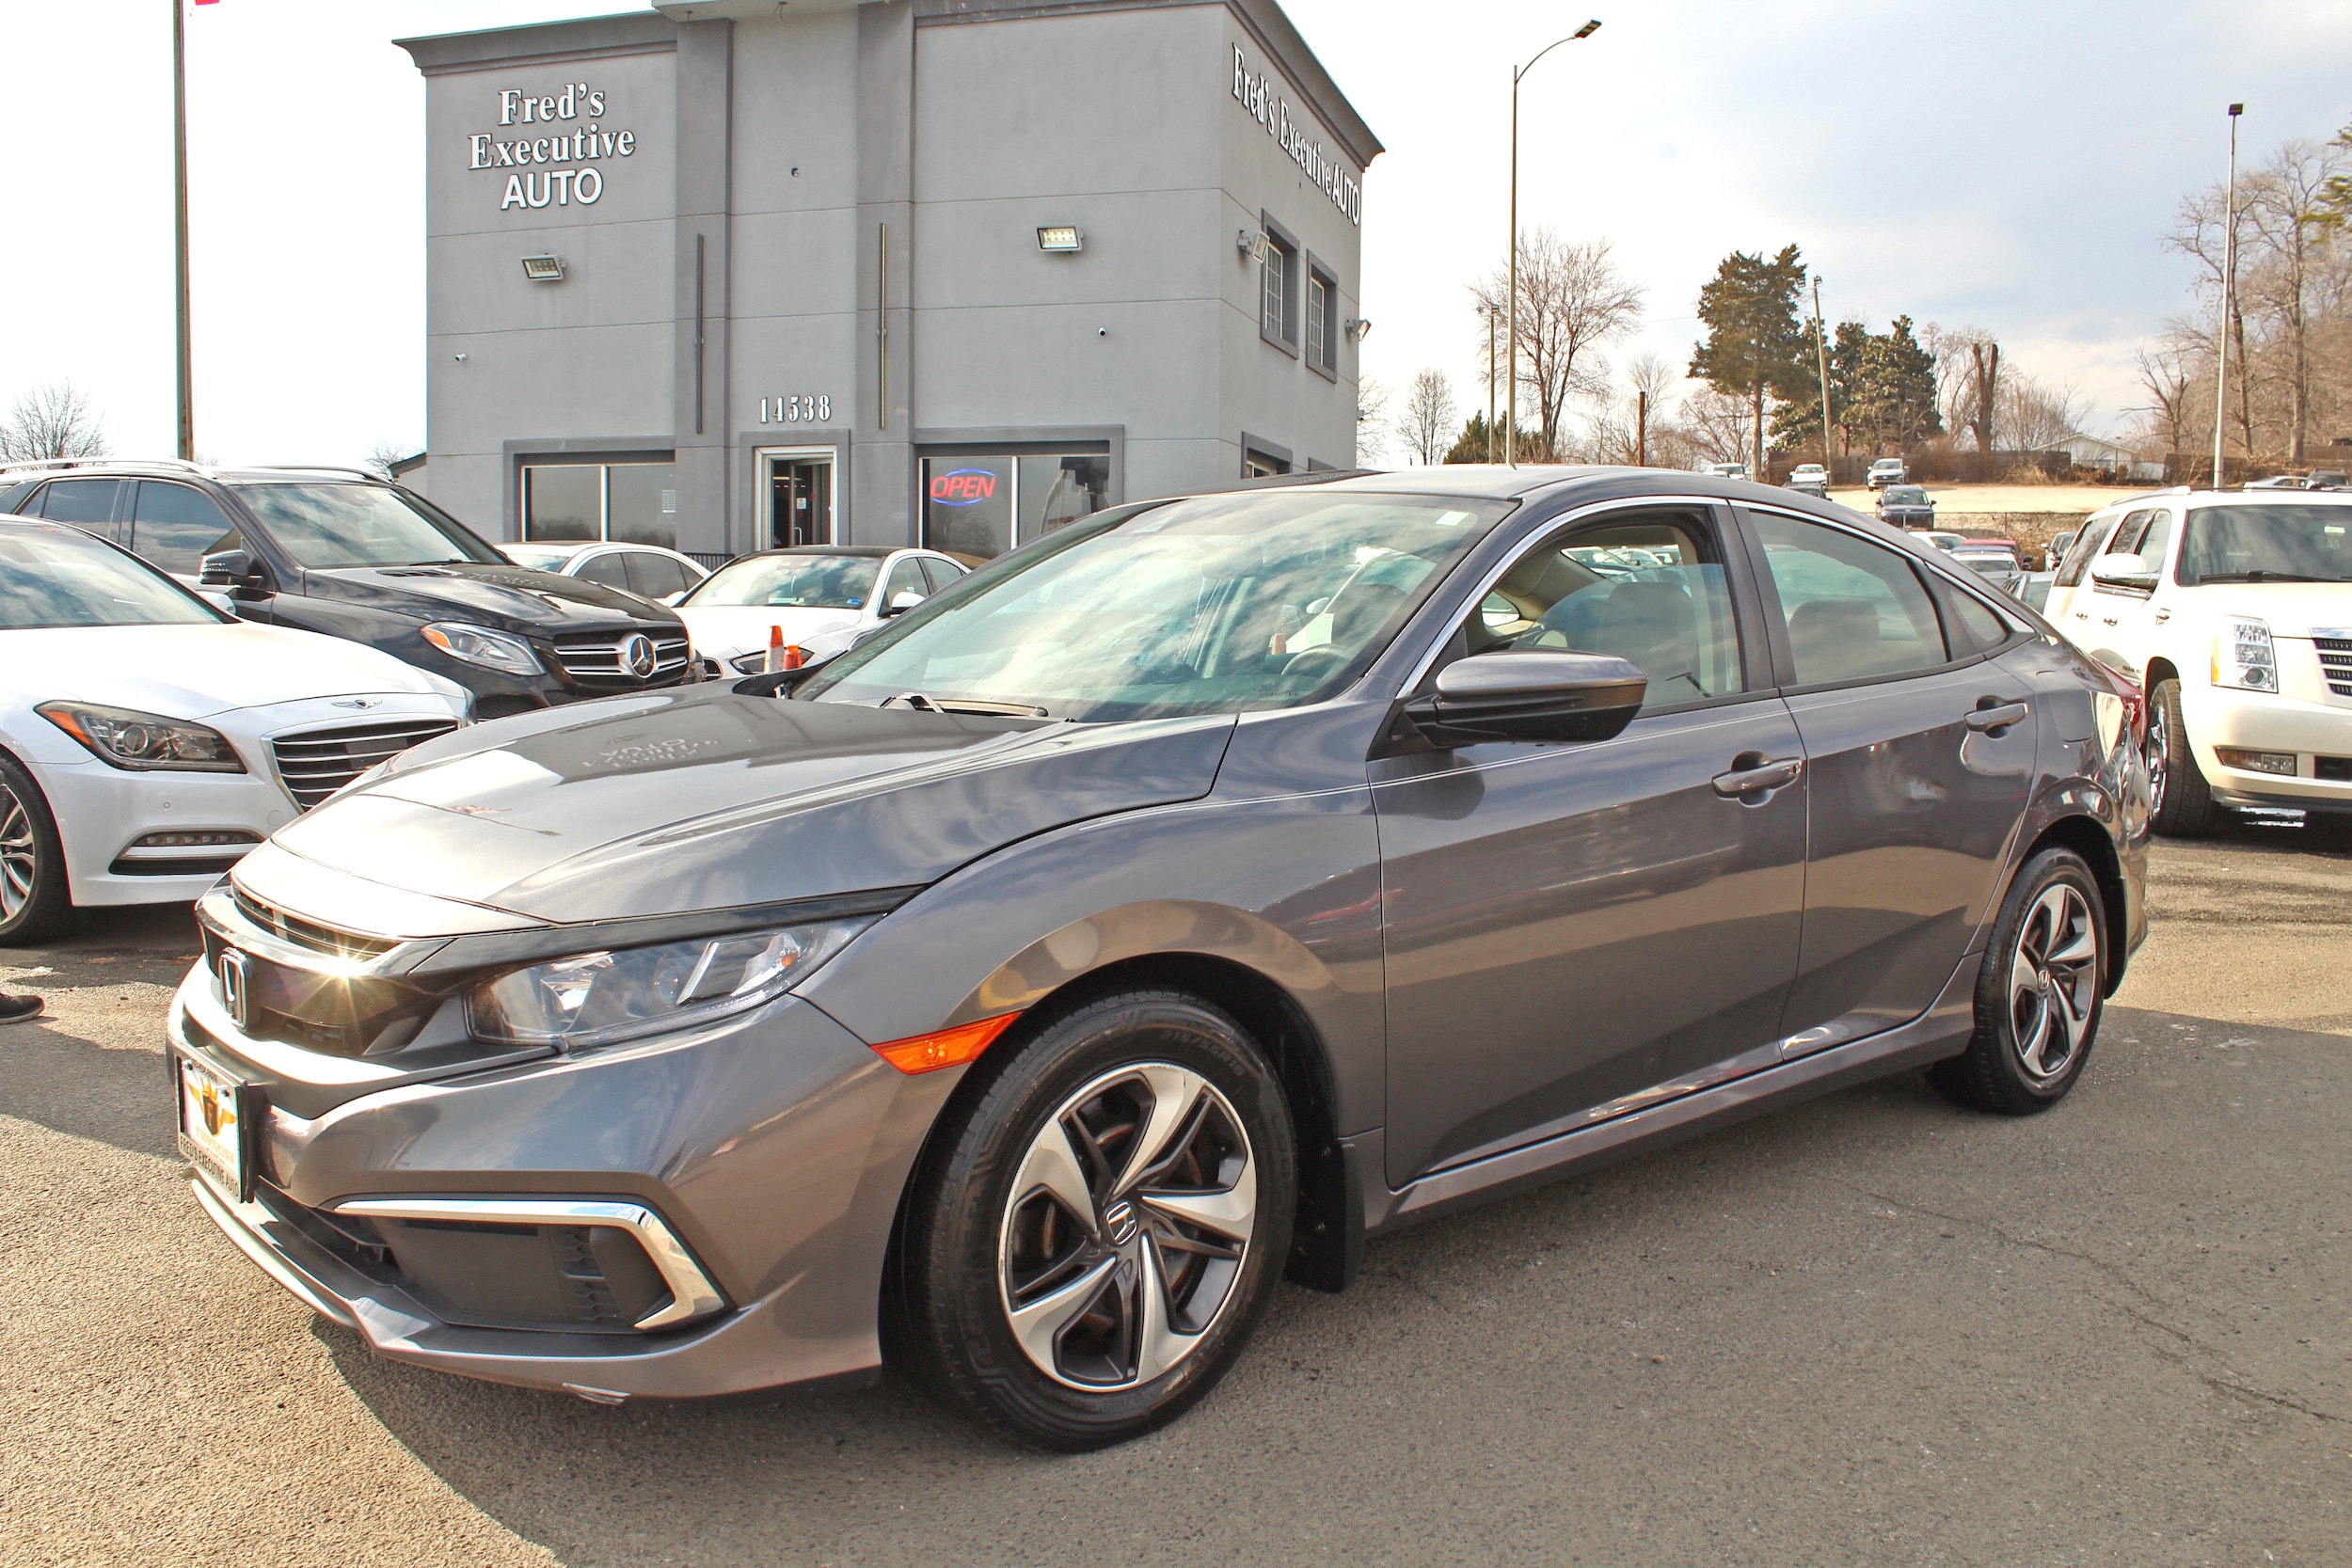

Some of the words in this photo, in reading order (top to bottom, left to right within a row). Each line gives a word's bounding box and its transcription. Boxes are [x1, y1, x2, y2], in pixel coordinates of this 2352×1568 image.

[498, 82, 606, 125] Fred's
[468, 123, 636, 170] Executive
[1232, 42, 1275, 135] Fred's
[1279, 96, 1331, 197] Executive
[1331, 162, 1360, 226] AUTO
[500, 166, 604, 210] AUTO
[759, 393, 832, 423] 14538
[930, 475, 997, 499] OPEN
[199, 1149, 225, 1185] EXECUTIVE
[225, 1173, 240, 1197] AUTO
